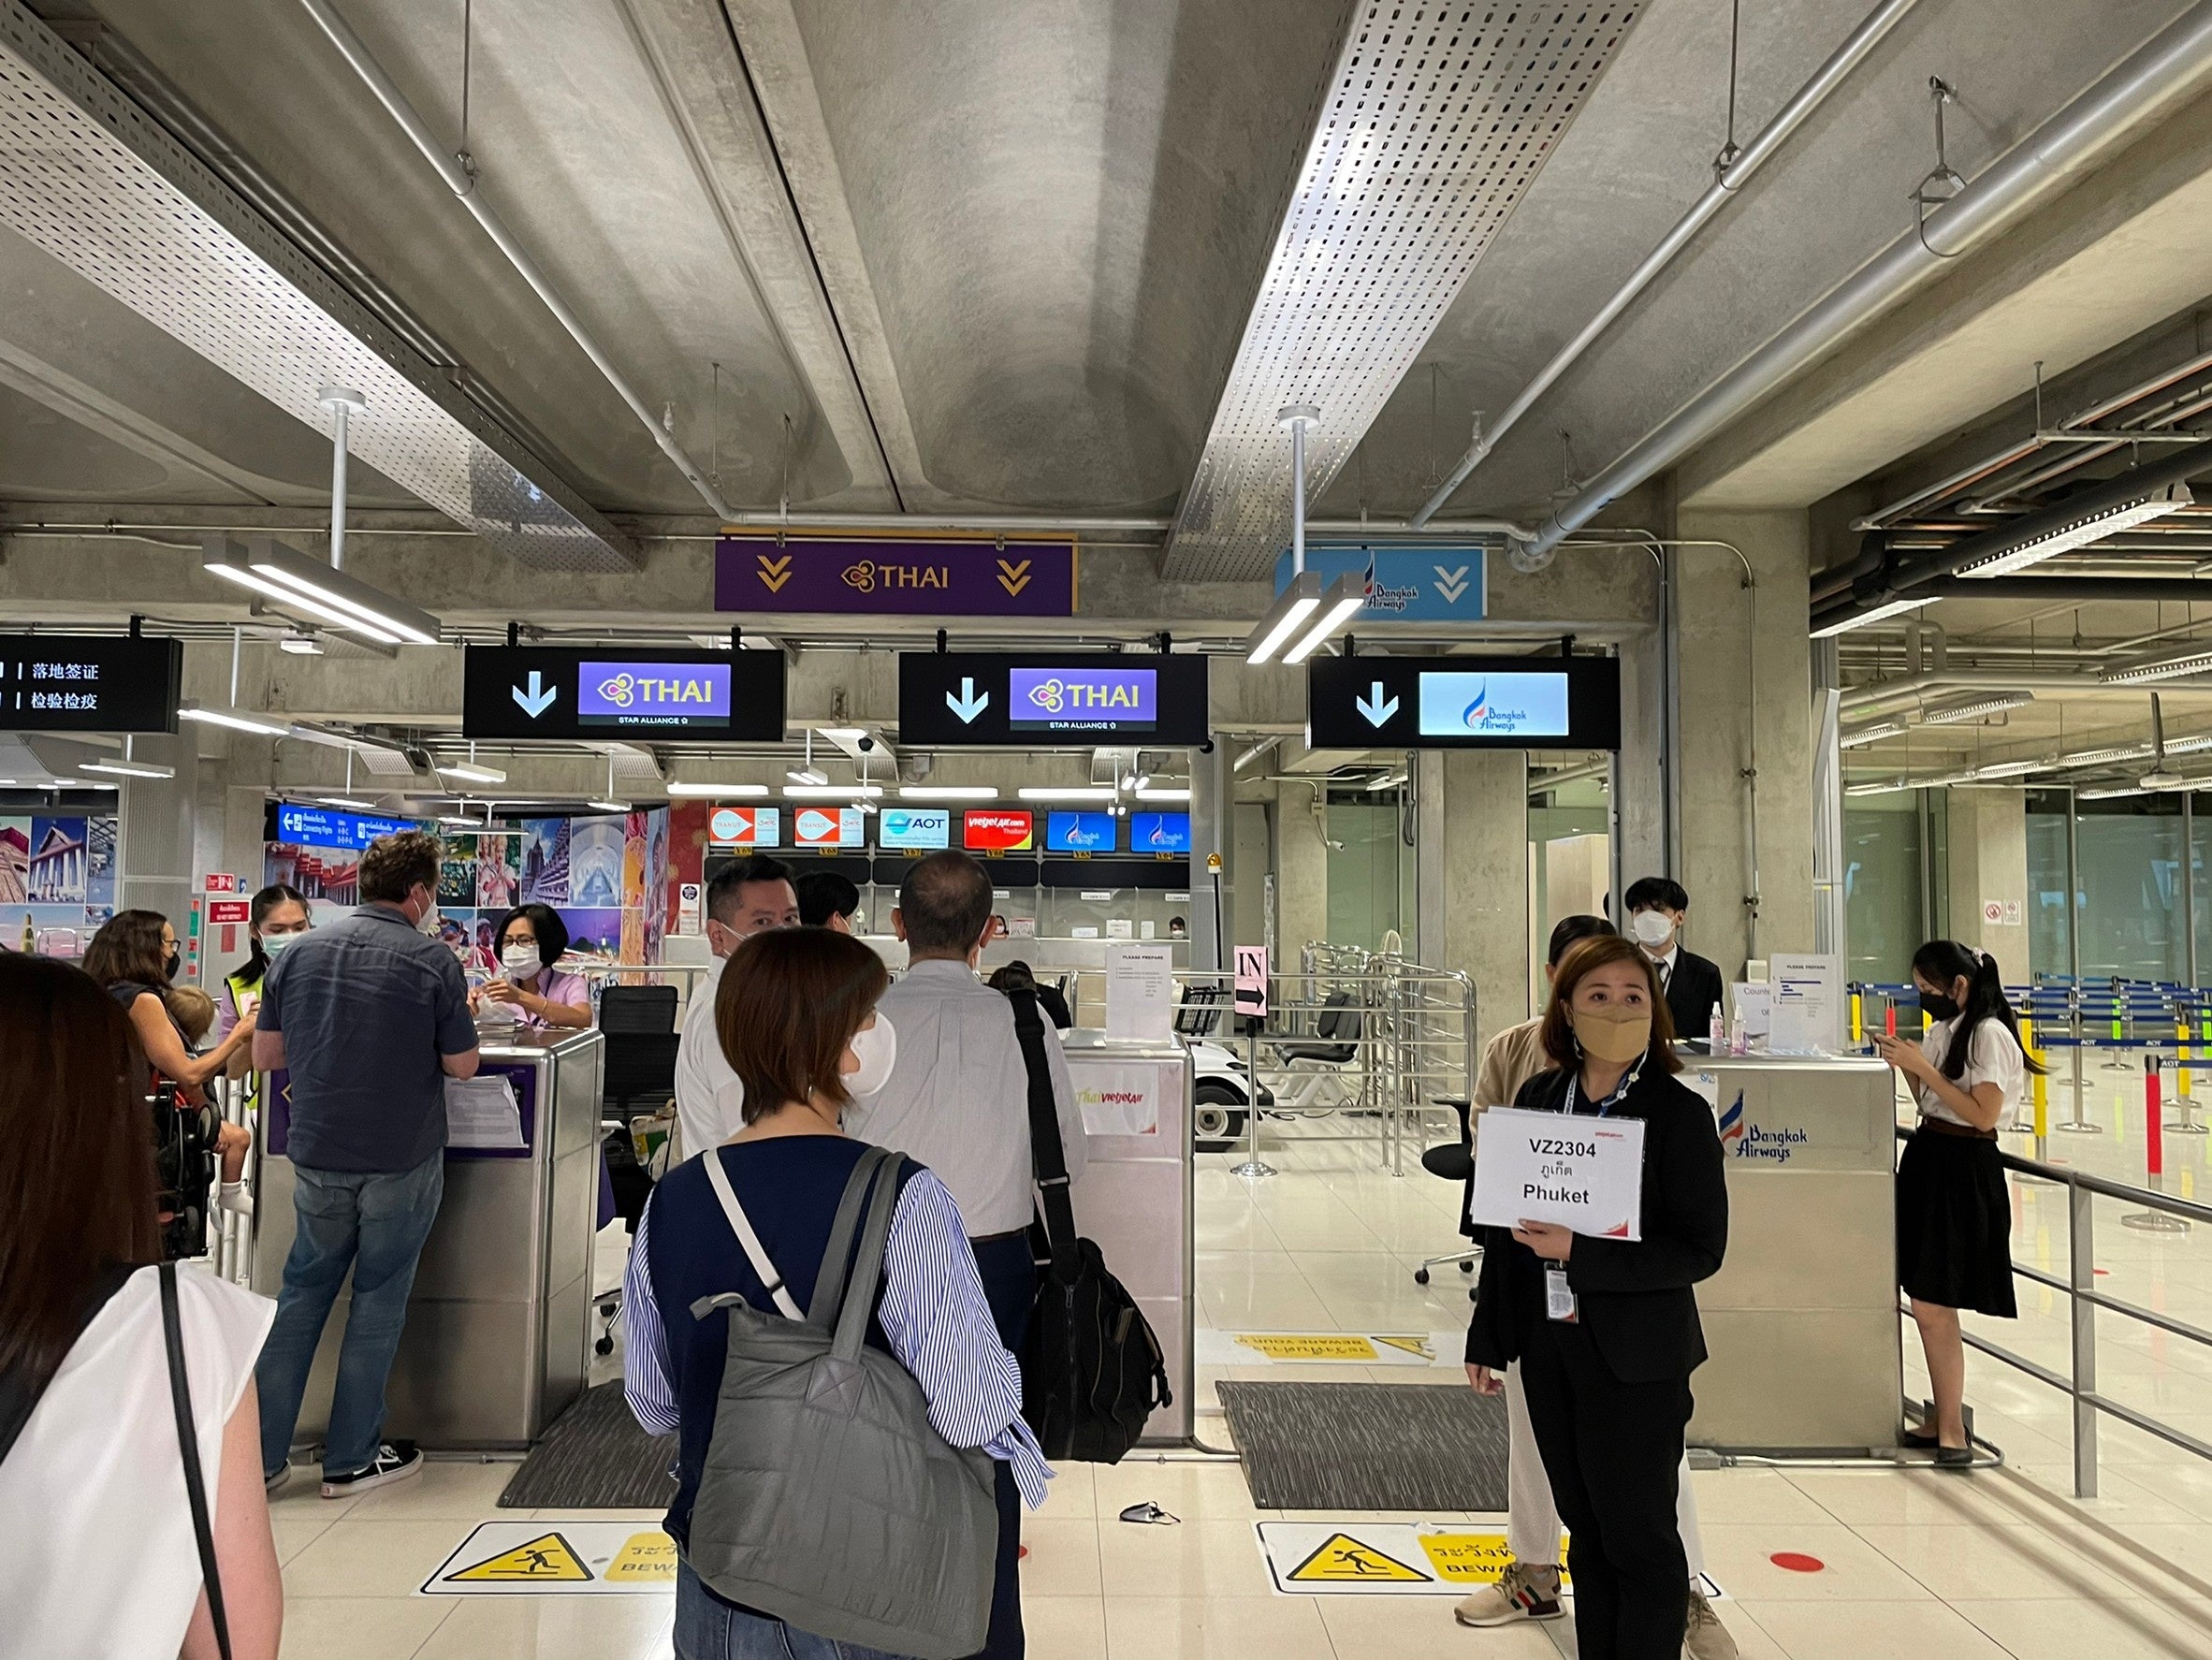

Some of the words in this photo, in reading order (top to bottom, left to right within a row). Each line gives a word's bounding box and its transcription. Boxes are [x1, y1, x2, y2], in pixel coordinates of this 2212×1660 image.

[878, 565, 949, 588] THAI
[1375, 582, 1419, 601] Bangkok
[1366, 594, 1406, 612] Airways
[32, 663, 99, 679] 落地签证
[636, 678, 713, 703] THAI
[1066, 684, 1140, 707] THAI
[31, 692, 97, 709] 检验检疫
[1489, 706, 1526, 722] Bangkok
[1479, 717, 1515, 732] Airways
[911, 818, 945, 829] AOT
[1239, 953, 1262, 977] IN
[1743, 987, 1770, 996] Counte
[1749, 1124, 1808, 1146] Bangkok
[1528, 1138, 1596, 1158] VZ2304
[1736, 1138, 1791, 1162] Airways
[1540, 1160, 1573, 1178] ภูเก็ต
[1523, 1184, 1590, 1204] Phuket
[621, 1563, 677, 1572] BEW
